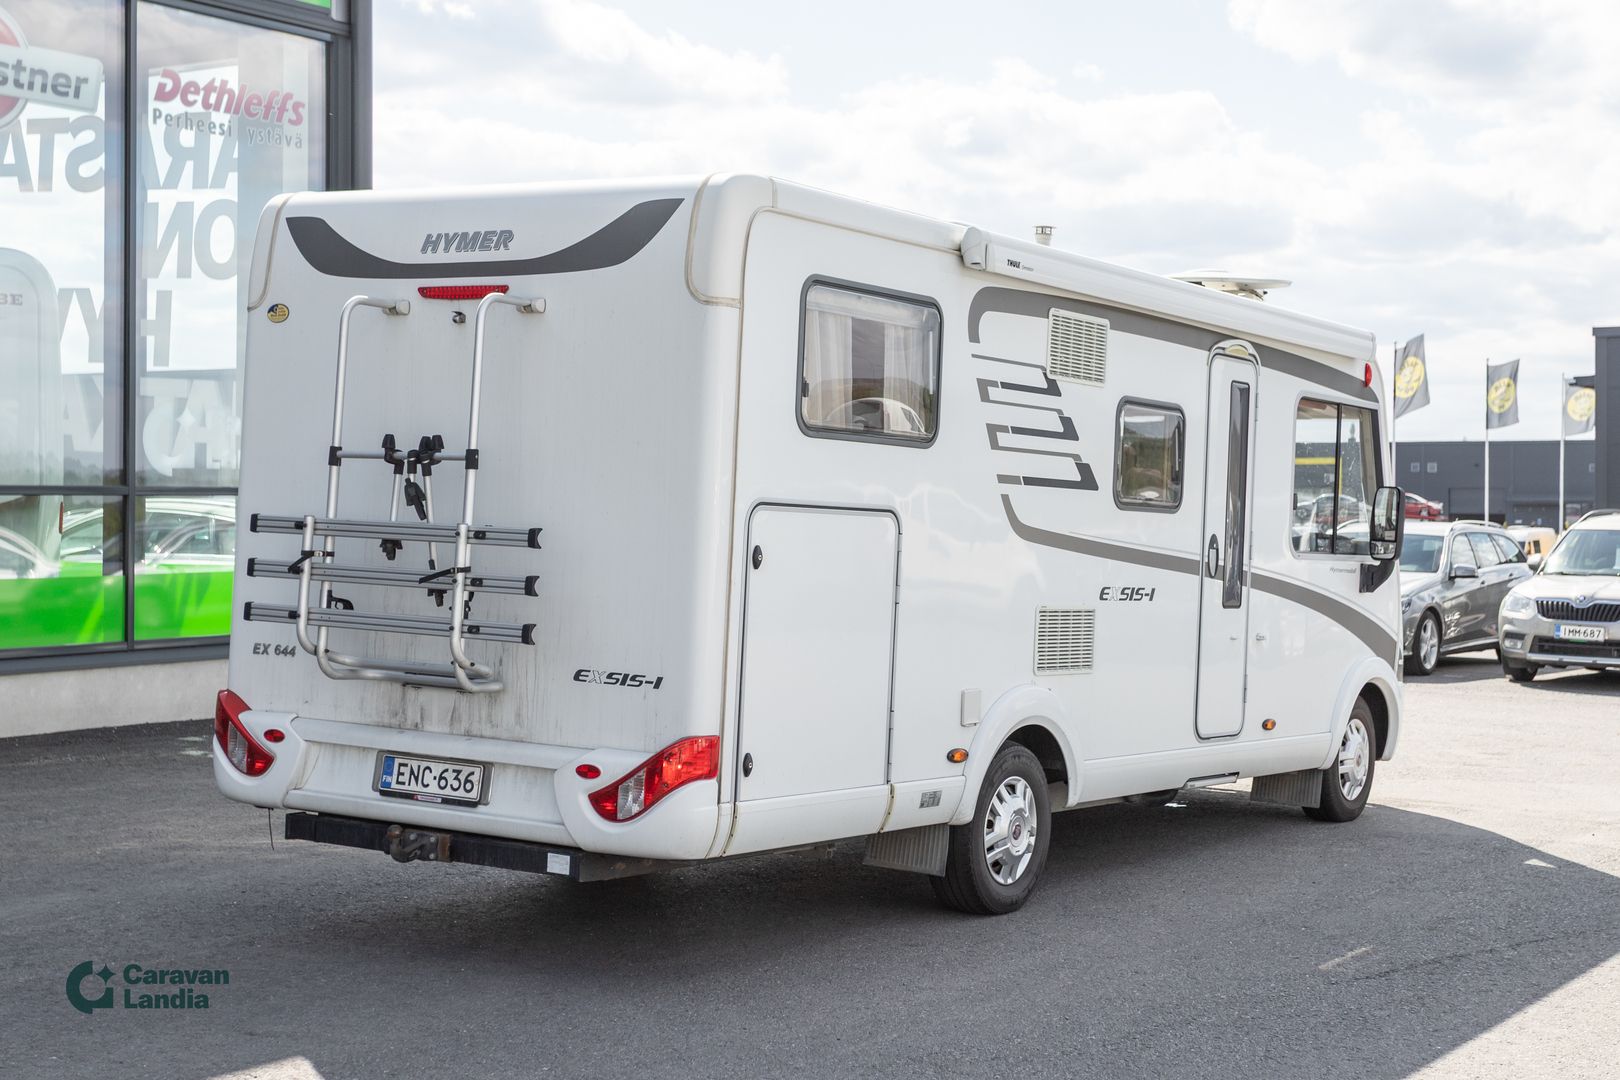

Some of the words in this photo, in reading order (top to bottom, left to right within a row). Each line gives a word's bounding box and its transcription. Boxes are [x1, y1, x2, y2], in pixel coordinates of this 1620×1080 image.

[154, 68, 305, 126] Dethleffs
[153, 108, 232, 136] Perheesi
[248, 127, 303, 149] ystävä
[420, 229, 515, 254] HYMER
[1099, 586, 1156, 602] EXSIS-I
[252, 642, 271, 656] EX
[274, 644, 296, 657] 644
[573, 668, 664, 690] EXSIS-I
[395, 762, 476, 794] ENC-636
